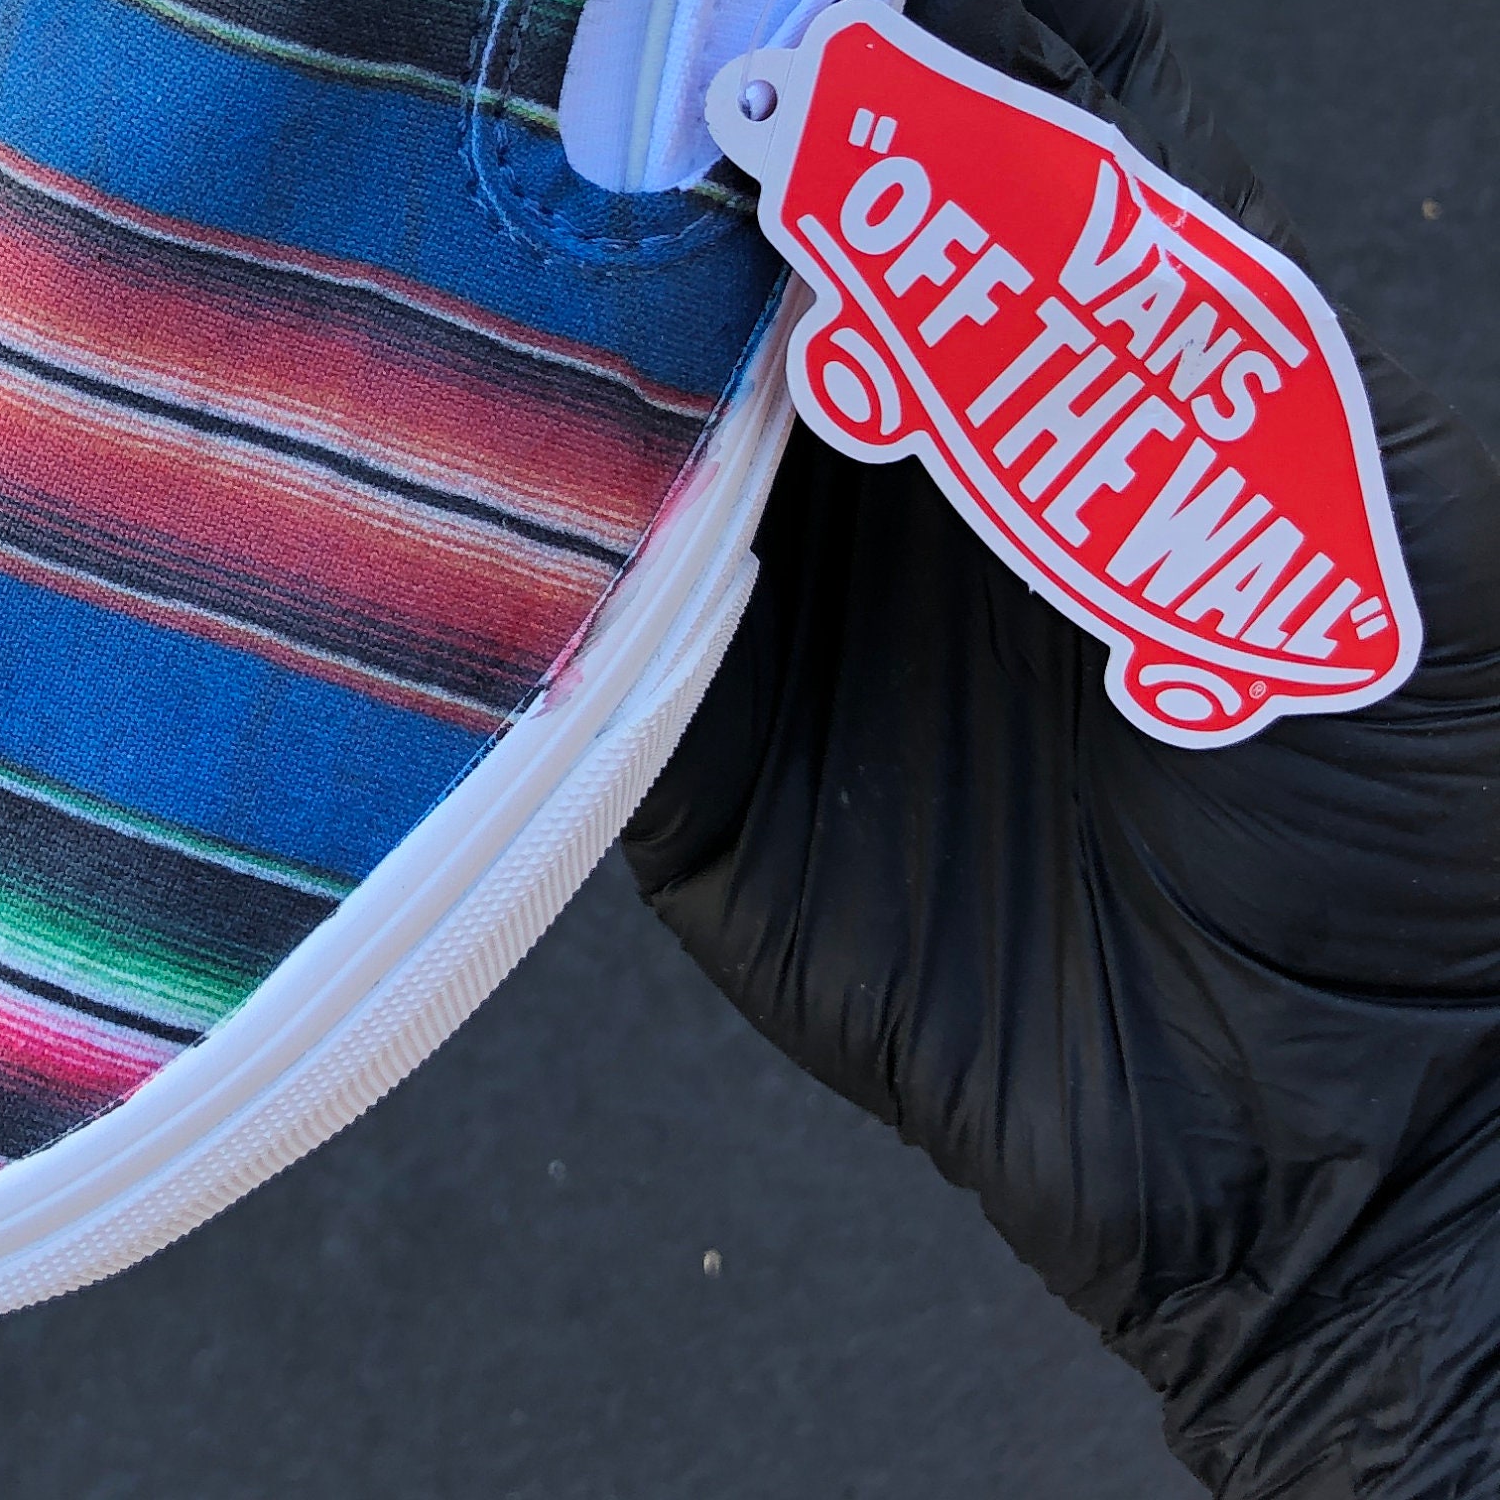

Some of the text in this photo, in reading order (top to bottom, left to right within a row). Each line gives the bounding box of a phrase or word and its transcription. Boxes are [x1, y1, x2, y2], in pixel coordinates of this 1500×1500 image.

[840, 108, 1387, 657] "OFF THE WALL"
[1060, 159, 1308, 442] VANS
